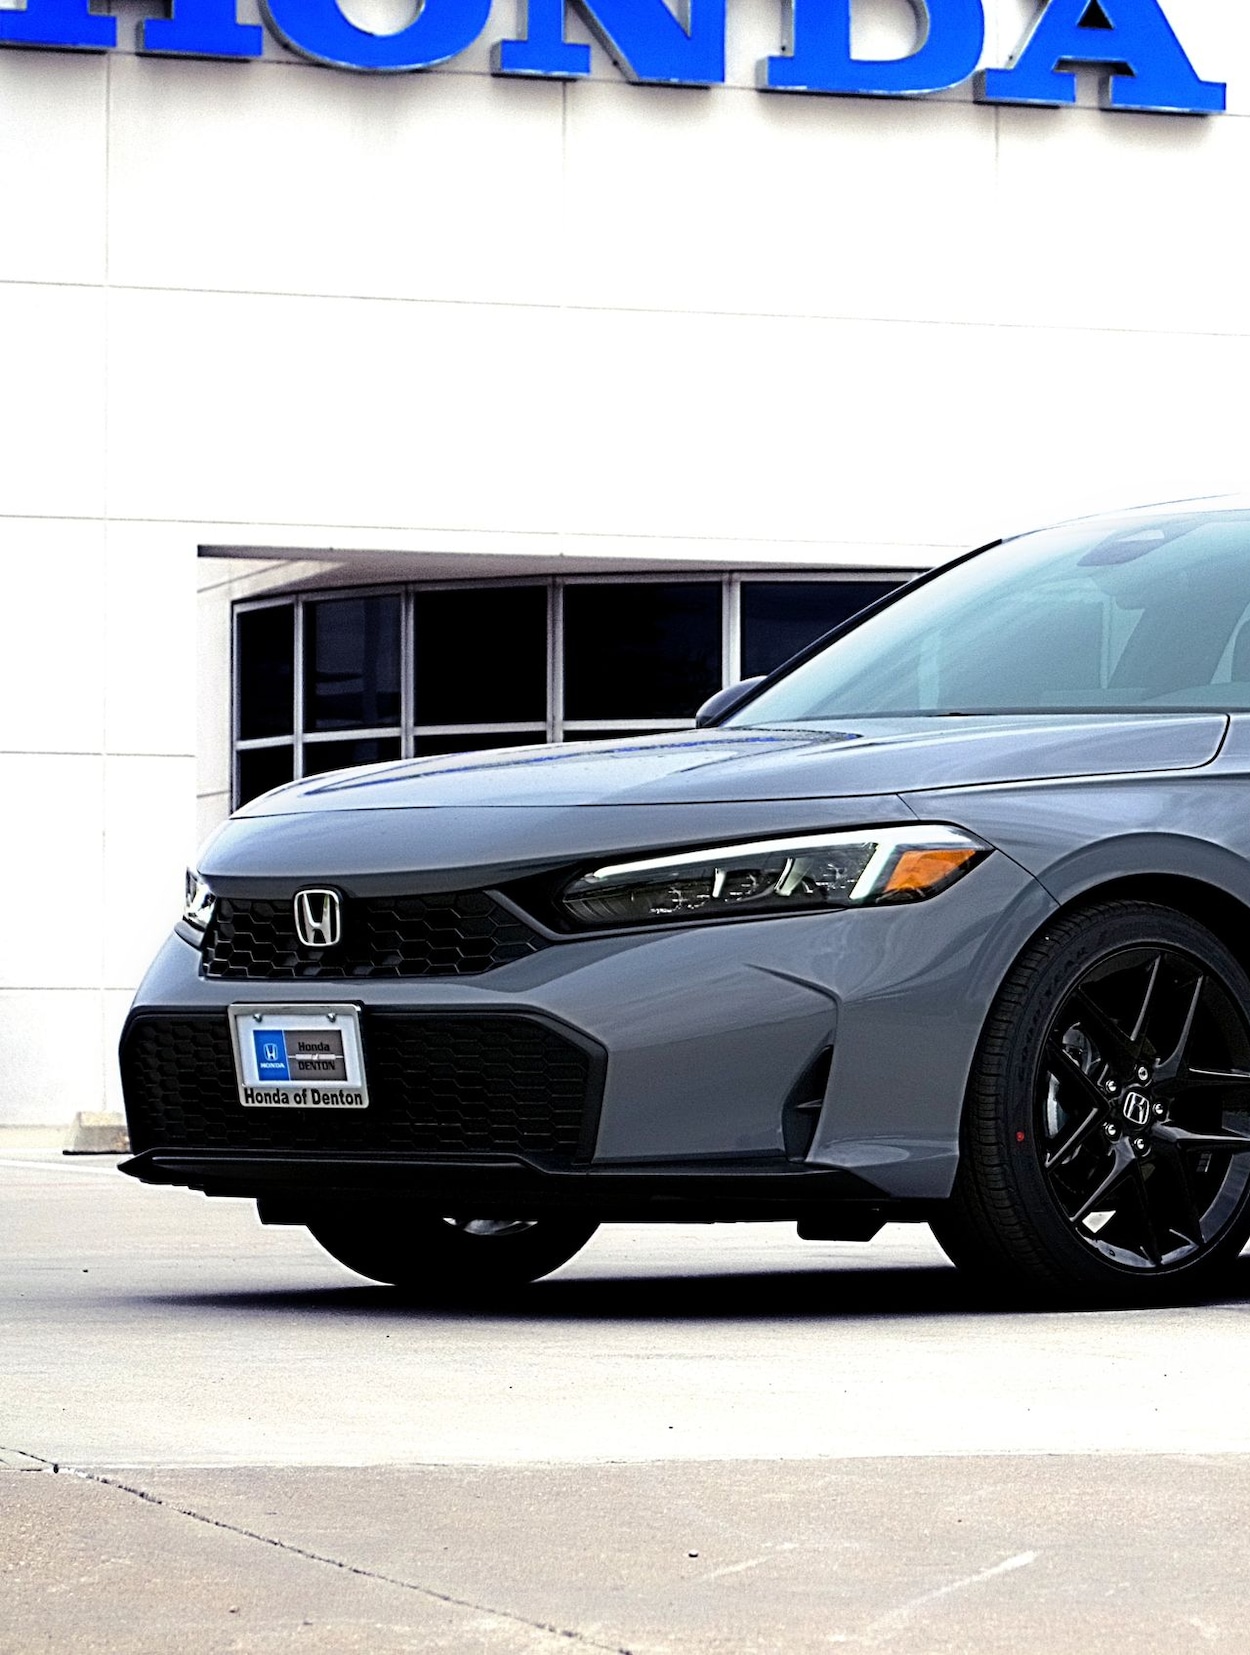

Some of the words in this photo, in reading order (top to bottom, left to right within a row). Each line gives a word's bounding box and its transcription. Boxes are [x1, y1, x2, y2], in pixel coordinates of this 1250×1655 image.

[298, 1041, 331, 1052] Honda
[298, 1061, 336, 1071] DENTON
[243, 1087, 290, 1105] Honda
[293, 1088, 307, 1106] of
[310, 1088, 364, 1106] Denton
